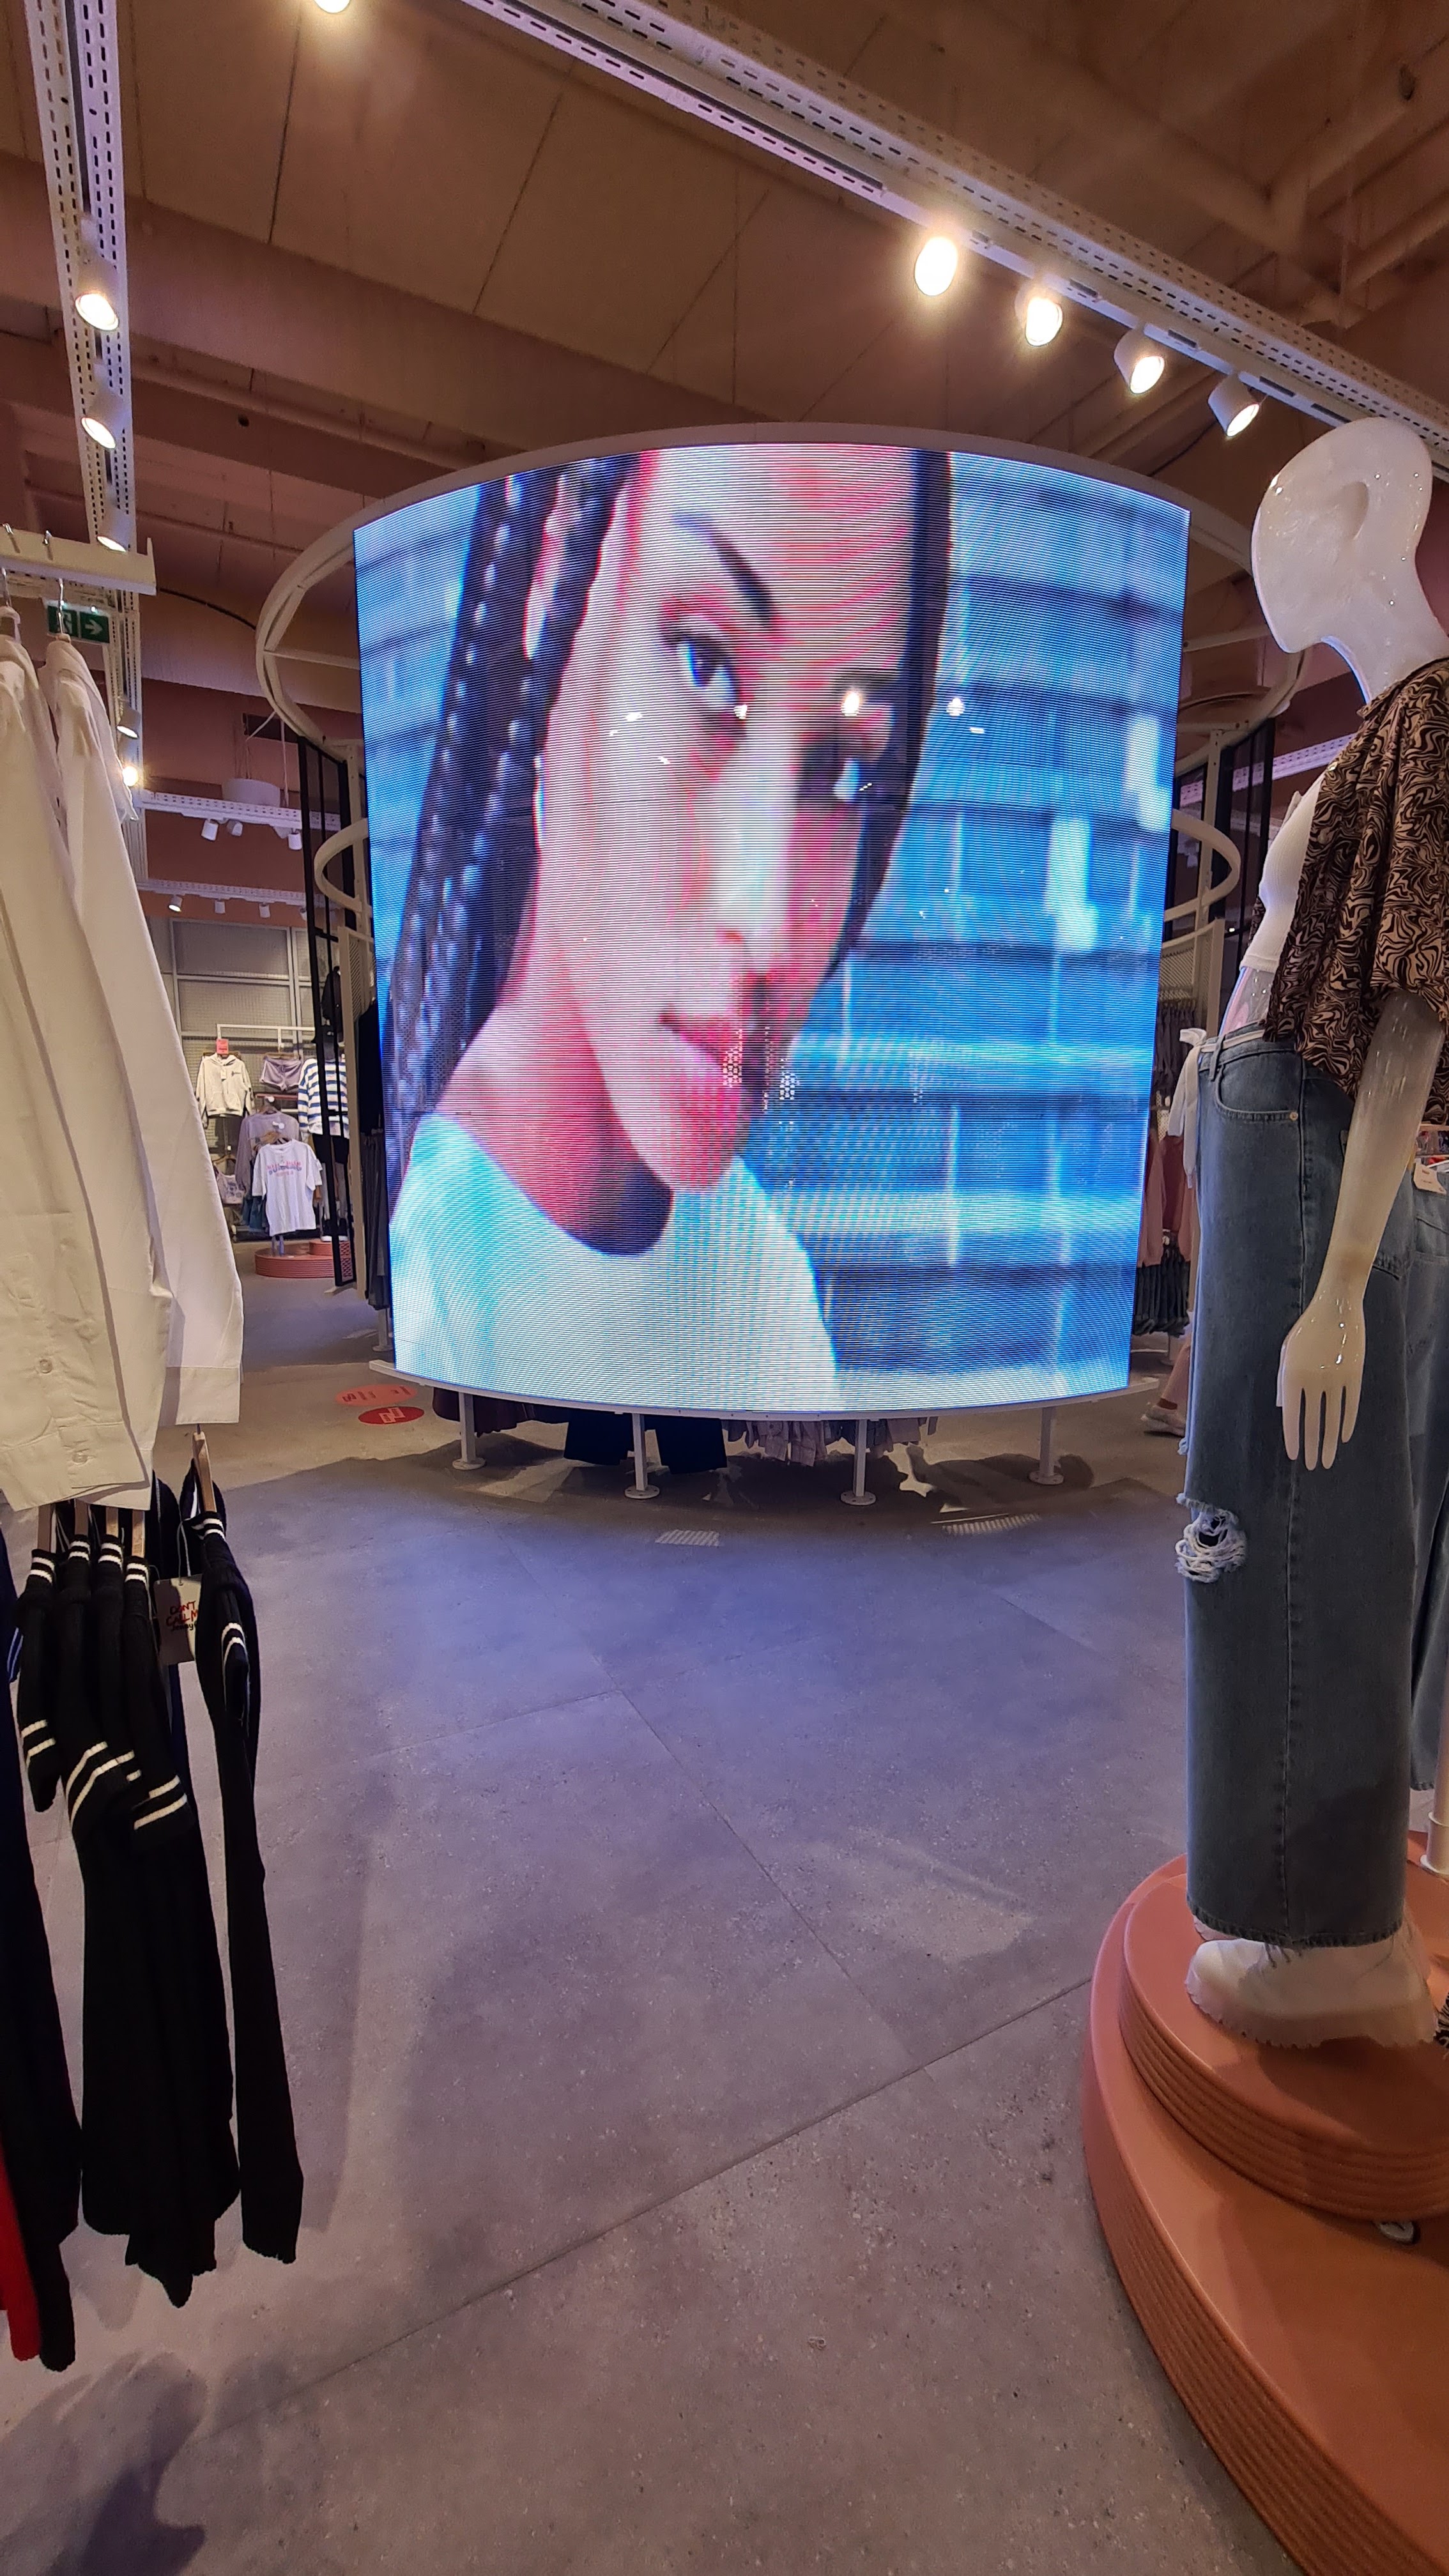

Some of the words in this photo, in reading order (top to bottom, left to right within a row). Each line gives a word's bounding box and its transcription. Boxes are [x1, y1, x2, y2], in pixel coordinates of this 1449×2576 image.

[166, 1613, 190, 1626] CALL
[191, 1609, 198, 1621] M
[171, 1621, 197, 1631] Jenny
